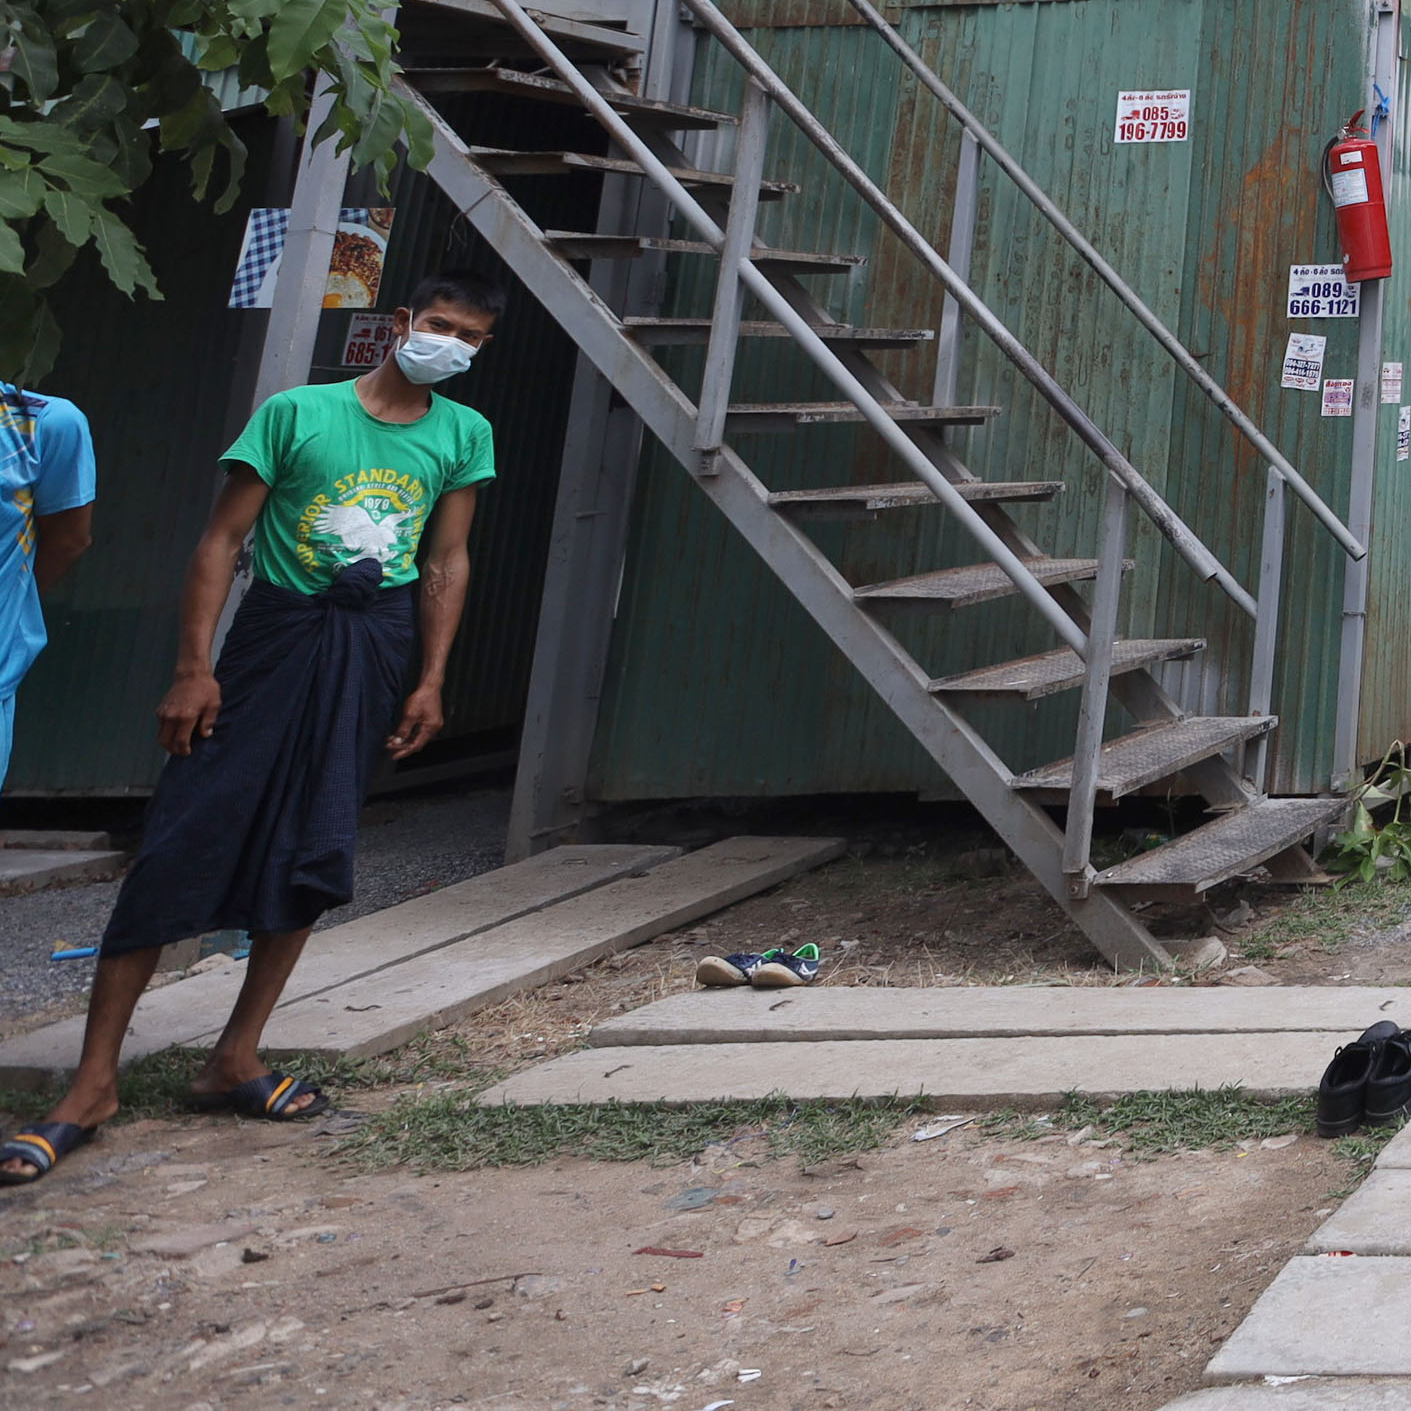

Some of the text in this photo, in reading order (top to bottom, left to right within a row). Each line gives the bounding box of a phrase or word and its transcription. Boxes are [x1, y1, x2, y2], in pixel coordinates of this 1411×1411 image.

[1142, 106, 1169, 121] 085
[1119, 121, 1187, 140] 196-7799
[1311, 282, 1343, 298] 089
[1289, 299, 1357, 315] 666-1121
[334, 468, 426, 502] STANDARD
